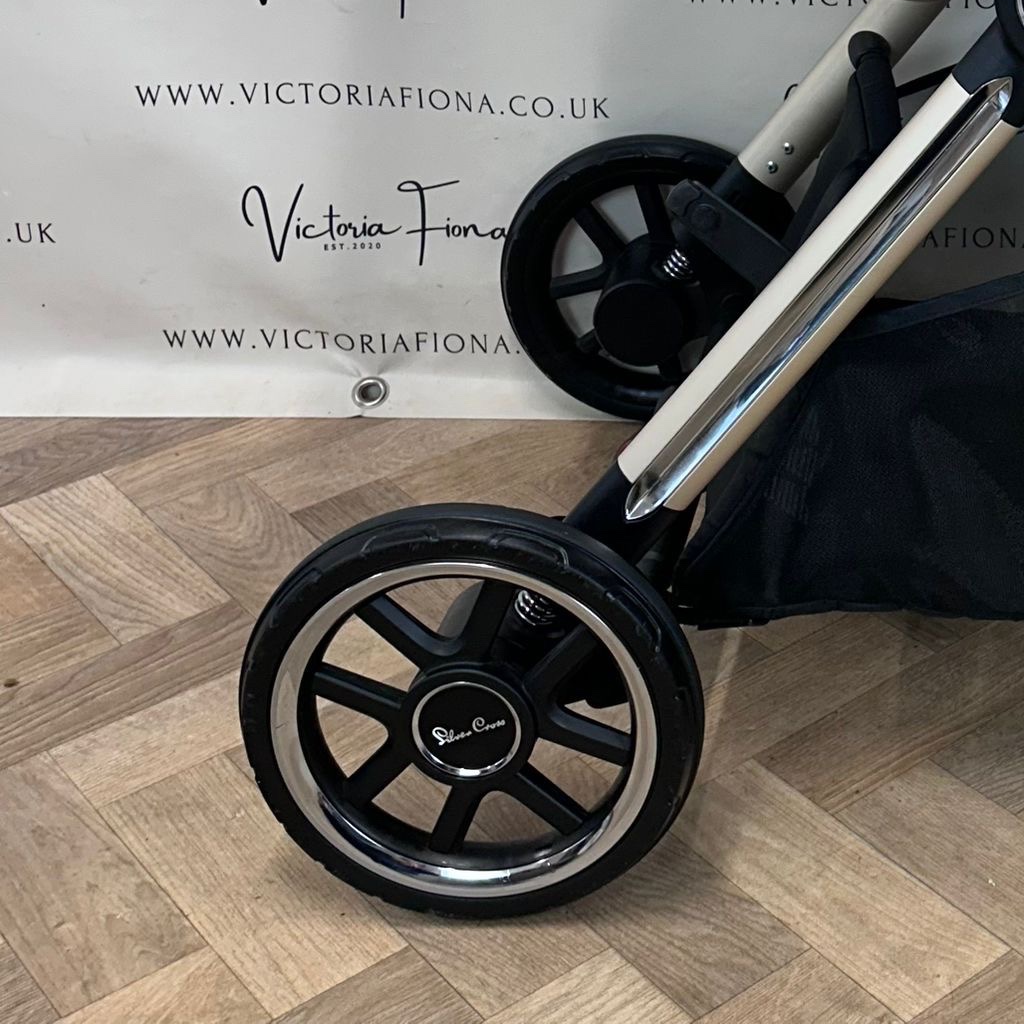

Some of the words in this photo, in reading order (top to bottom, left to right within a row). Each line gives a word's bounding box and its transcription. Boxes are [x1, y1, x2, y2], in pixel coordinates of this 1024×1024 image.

[135, 82, 611, 120] WWW.VICTORIAFIONA.CO.UK
[242, 183, 402, 262] Victoria
[397, 180, 508, 266] Fiona
[324, 242, 382, 251] EST.2020
[432, 727, 472, 746] Silver
[472, 717, 506, 732] Cross
